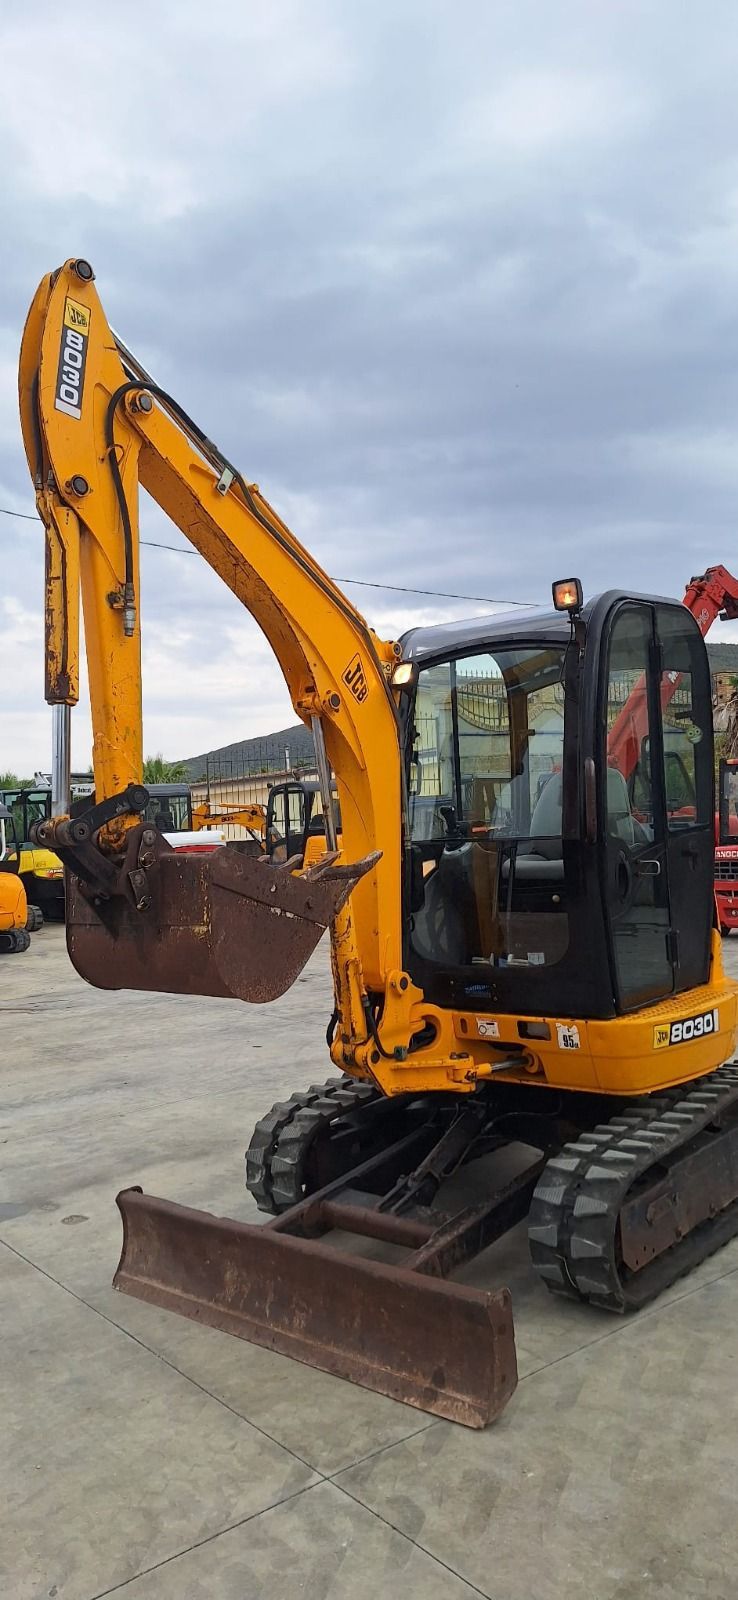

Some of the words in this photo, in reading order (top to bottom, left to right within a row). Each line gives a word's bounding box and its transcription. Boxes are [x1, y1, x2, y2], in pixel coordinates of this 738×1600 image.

[69, 305, 87, 327] JCB
[60, 329, 84, 406] 8030
[344, 662, 368, 702] JCB
[562, 1034, 575, 1048] 95
[671, 1013, 713, 1043] 8030
